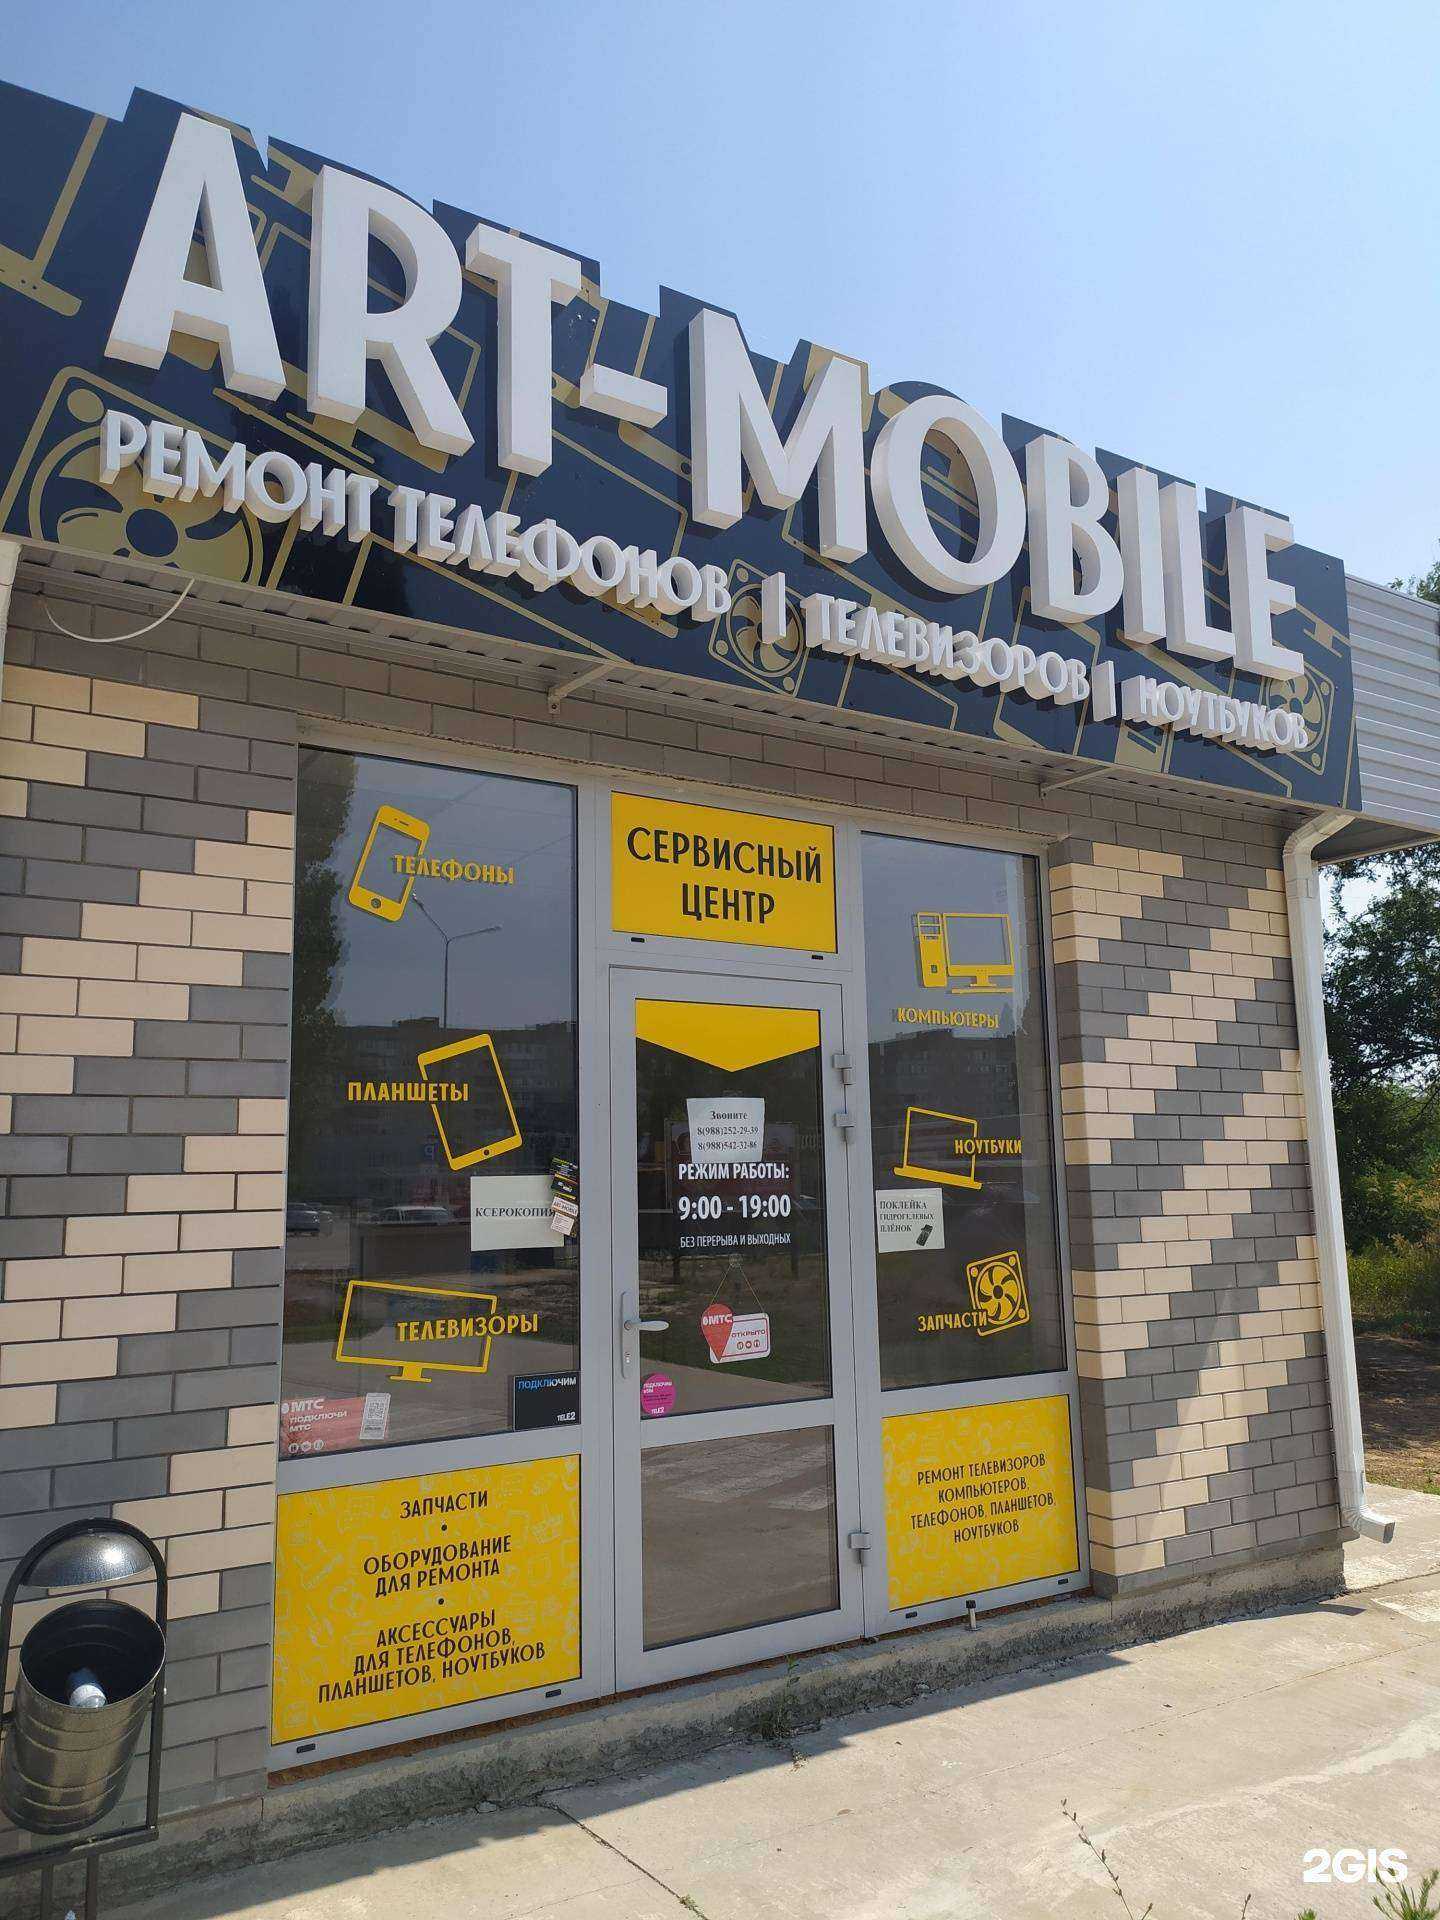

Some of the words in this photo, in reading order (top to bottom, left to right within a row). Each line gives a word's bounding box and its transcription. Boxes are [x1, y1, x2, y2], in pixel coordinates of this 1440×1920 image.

[104, 111, 1305, 682] ART-MOBILE
[100, 410, 379, 543] РЕМОНТ
[388, 485, 732, 624] ТЕЛЕФОНОВ
[803, 592, 1091, 704] ТЕЛЕВИЗОРОВ
[1121, 674, 1309, 754] НОУТБУКОВ
[627, 826, 822, 884] СЕРВИСНЫЙ
[393, 854, 515, 885] ТЕЛЕФОНЫ
[682, 883, 775, 924] ЦЕНТР
[897, 1007, 1000, 1030] КОМПЬЮТЕРЫ
[347, 1081, 470, 1102] ПЛАНШЕТЫ
[710, 1110, 748, 1120] Звоните
[954, 1138, 1023, 1155] НОУТБУКИ
[678, 1163, 730, 1180] РЕЖИМ
[733, 1162, 790, 1179] РАБОТЫ:
[678, 1195, 722, 1221] 9:00
[738, 1194, 792, 1219] 19:00
[880, 1199, 928, 1210] ПОКЛЕЙКА
[680, 1236, 695, 1249] БЕЗ
[697, 1235, 738, 1248] ПЕРЕРЫВА
[739, 1235, 746, 1246] И
[747, 1232, 792, 1246] ВЫХОДНЫХ
[397, 1313, 540, 1342] ТЕЛЕВИЗОРЫ
[917, 1310, 989, 1333] ЗАПЧАСТИ
[518, 1376, 577, 1390] ПОДКЛЮЧИМ
[556, 1410, 577, 1422] TELE2
[917, 1465, 965, 1485] РЕМОНТ
[938, 1476, 1030, 1504] КОМПЬЮТЕРОВ,
[399, 1490, 488, 1519] ЗАПЧАСТИ
[953, 1519, 1020, 1543] НОУТБУКОВ
[363, 1534, 512, 1575] ОБОРУДОВАНИЕ
[375, 1574, 410, 1598] ДЛЯ
[417, 1558, 500, 1588] РЕМОНТА
[376, 1608, 496, 1648] АКСЕССУАРЫ
[353, 1651, 389, 1676] ДЛЯ
[396, 1627, 515, 1667] ТЕЛЕФОНОВ,
[318, 1665, 436, 1704] ПЛАНШЕТОВ,
[442, 1642, 546, 1680] НОУТБУКОВ
